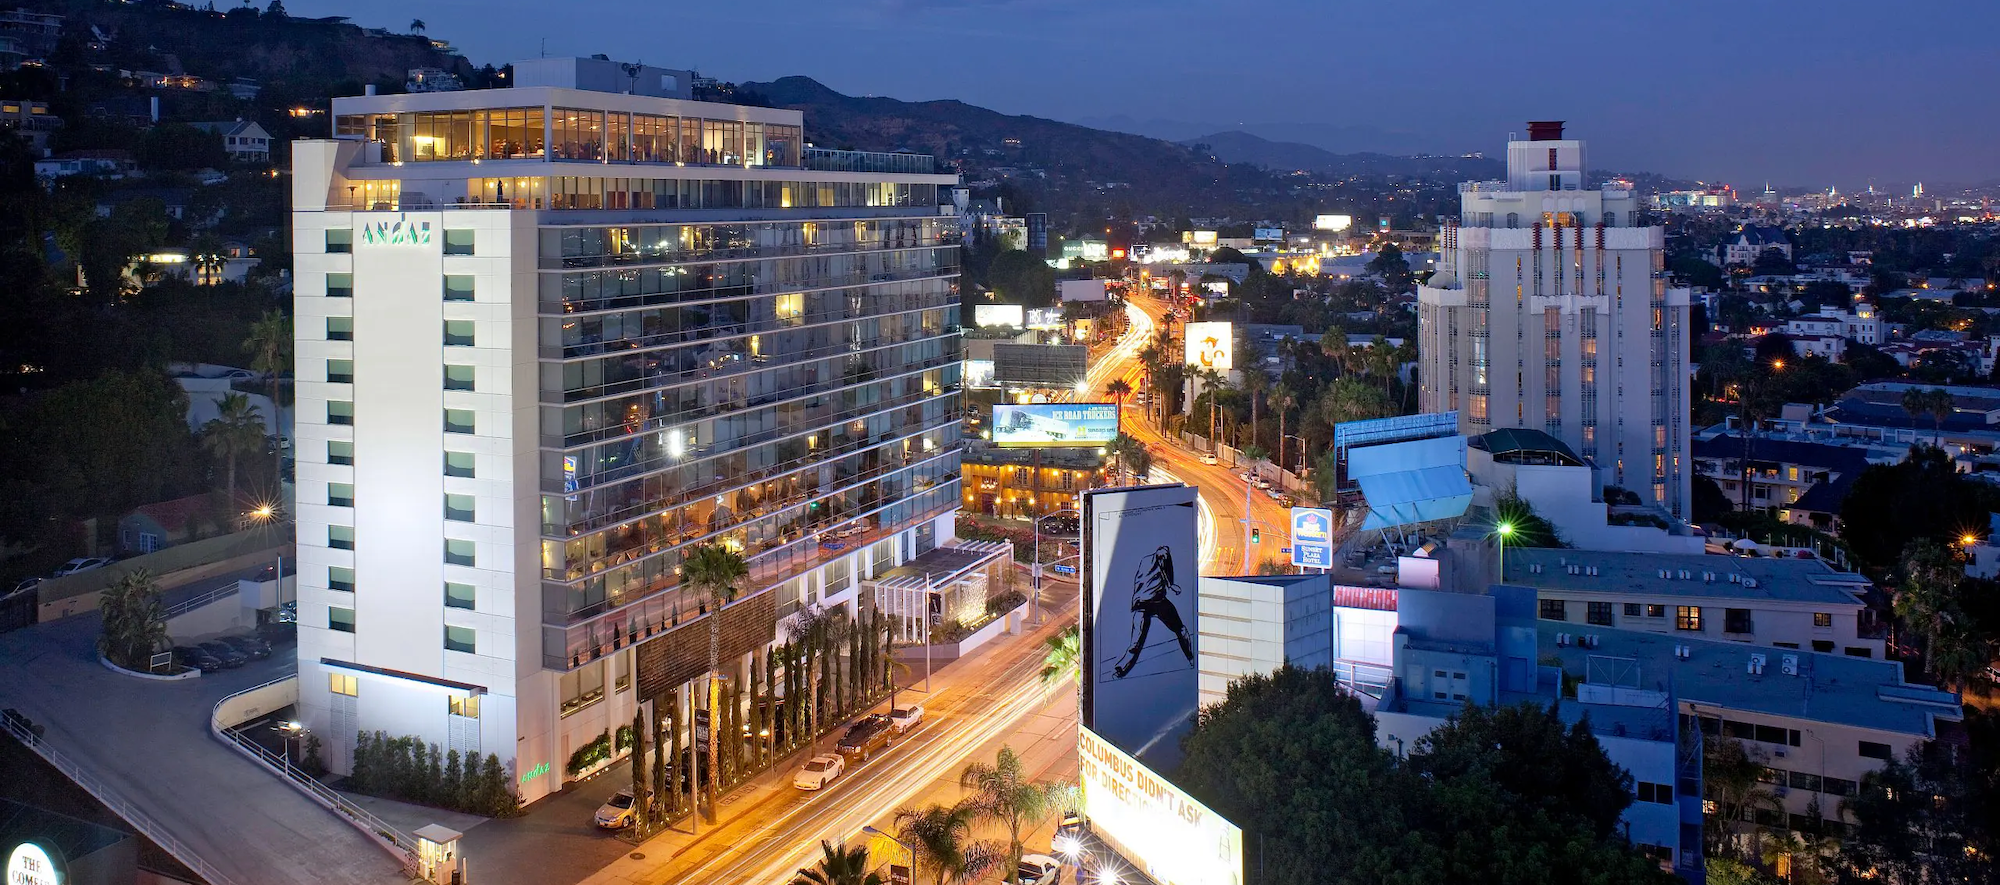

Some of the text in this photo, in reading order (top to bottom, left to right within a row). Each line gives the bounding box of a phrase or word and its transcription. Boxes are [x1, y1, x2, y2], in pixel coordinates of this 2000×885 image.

[1063, 410, 1082, 420] ROAD
[1083, 410, 1116, 420] TRUCKERS
[1297, 528, 1327, 539] Western
[1302, 521, 1320, 532] Best
[1079, 755, 1098, 782] FOR
[1079, 732, 1203, 827] COLUMBUS DIDN'T ASK
[22, 855, 42, 873] THE
